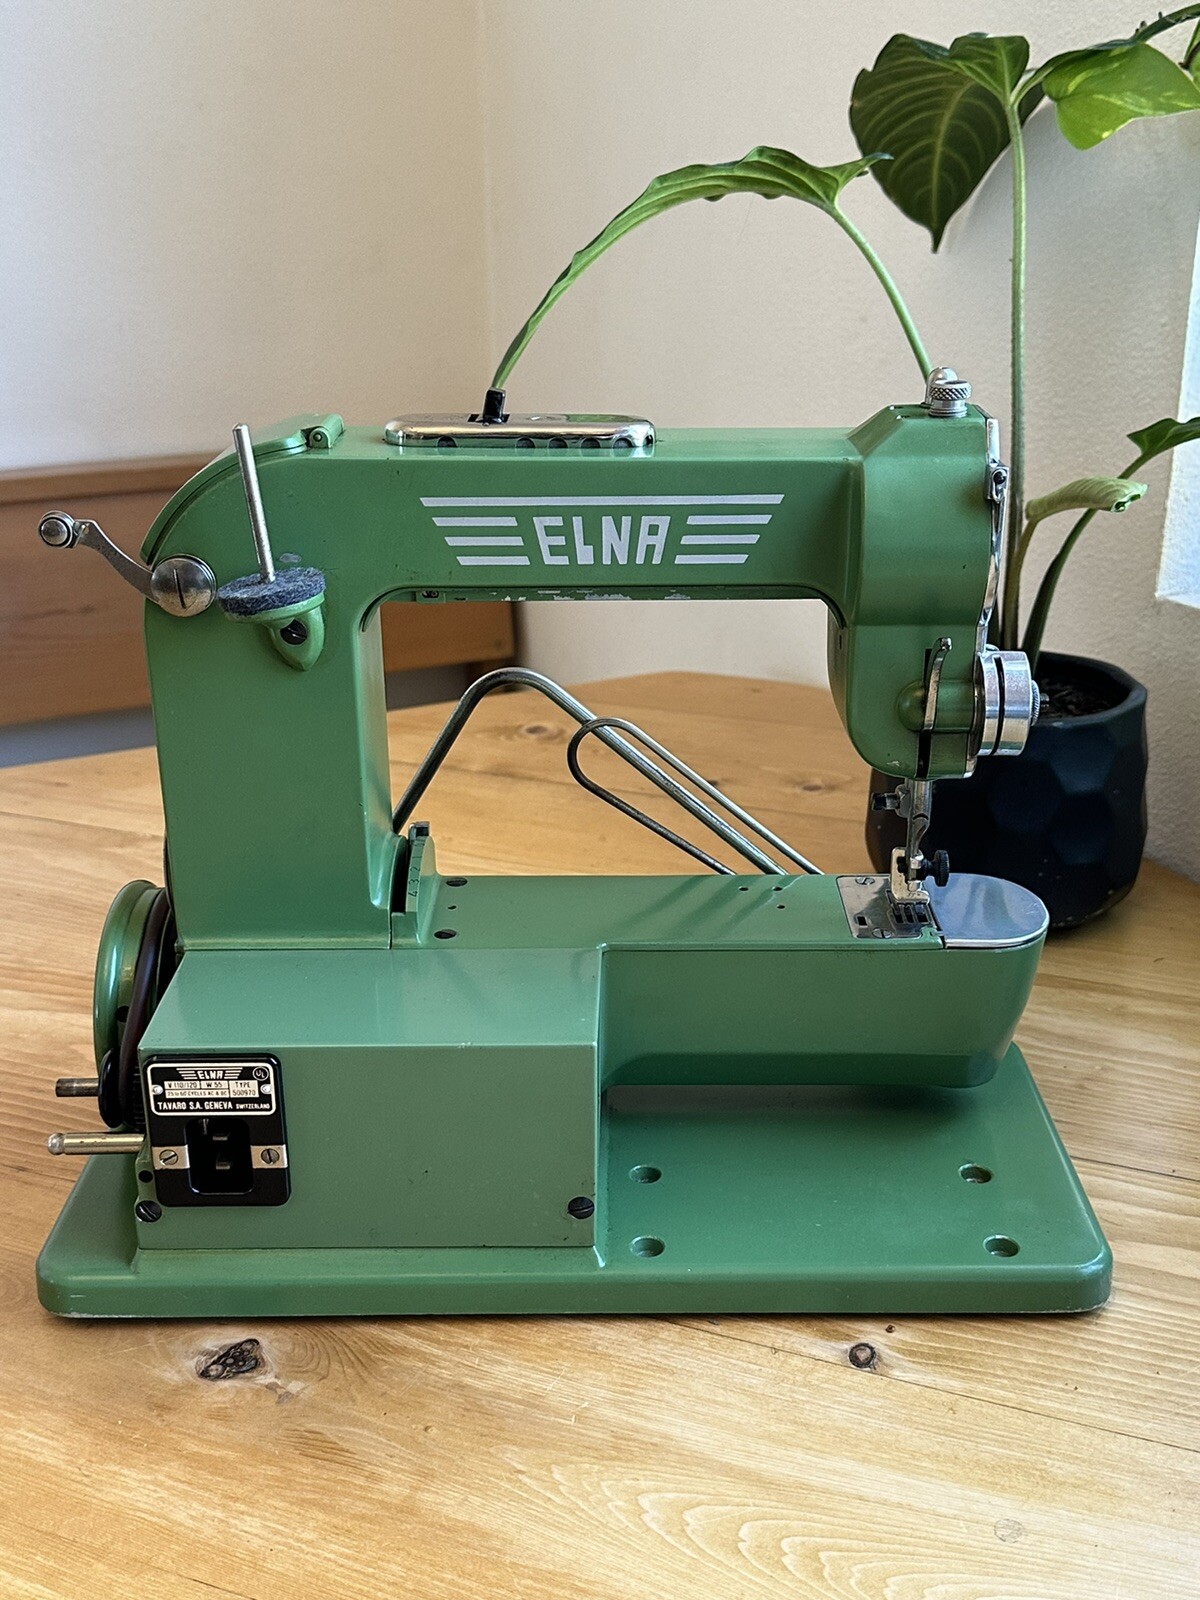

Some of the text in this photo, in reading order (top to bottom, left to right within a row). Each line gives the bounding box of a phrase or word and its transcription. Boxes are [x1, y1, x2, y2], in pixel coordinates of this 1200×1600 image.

[532, 515, 671, 565] ELNA
[197, 1070, 224, 1080] ELNA
[173, 1081, 198, 1089] 110/120
[157, 1101, 187, 1110] TAVARO
[189, 1101, 204, 1110] S.A.
[204, 1101, 233, 1110] GENEVA
